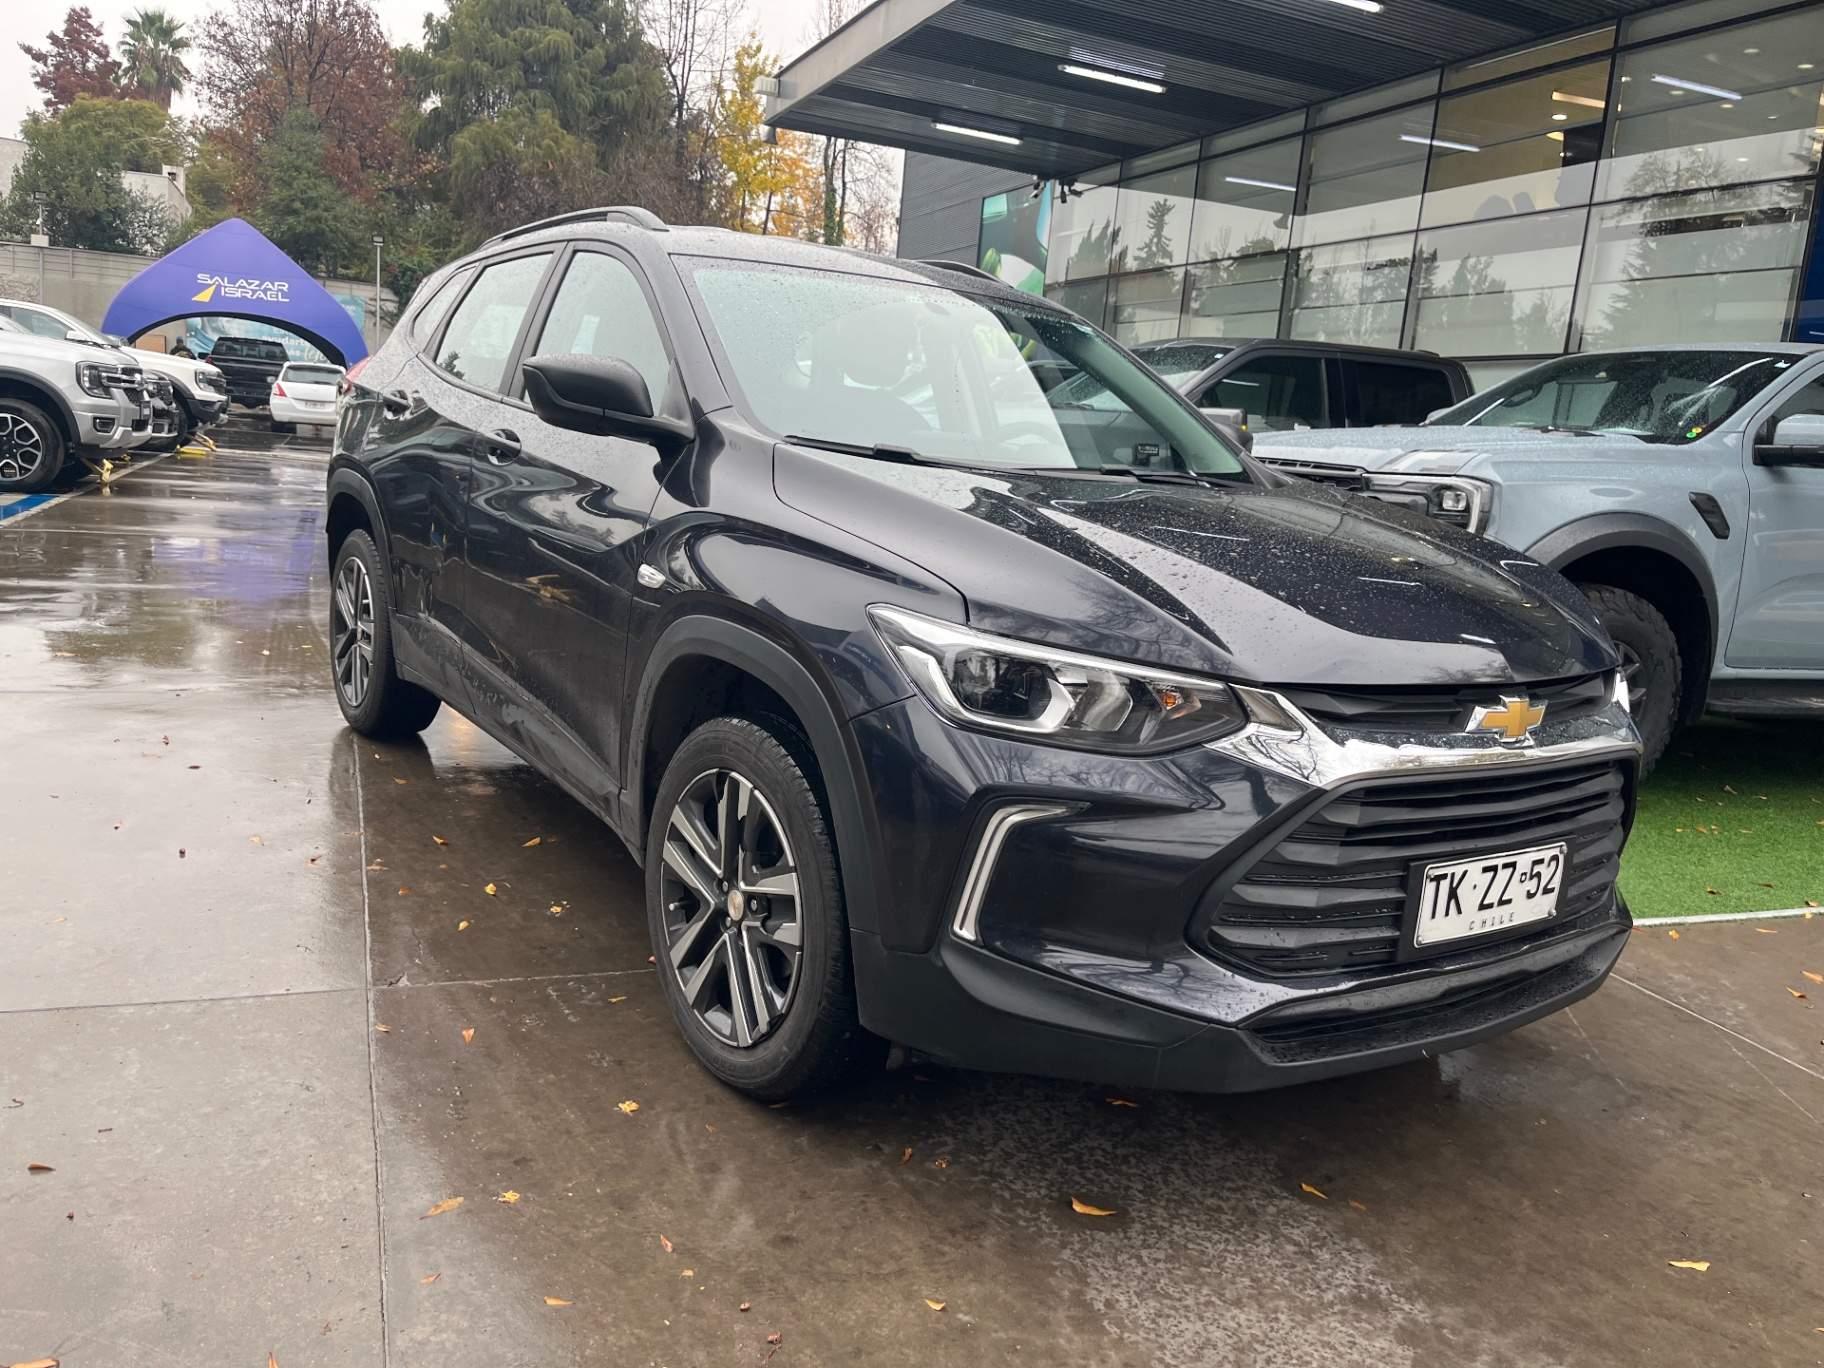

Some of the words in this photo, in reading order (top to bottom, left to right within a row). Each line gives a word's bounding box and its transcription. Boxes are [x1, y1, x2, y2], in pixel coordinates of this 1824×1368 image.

[197, 273, 288, 292] SALAZAR
[221, 286, 290, 302] ISRAEL
[1469, 911, 1515, 930] CHILE
